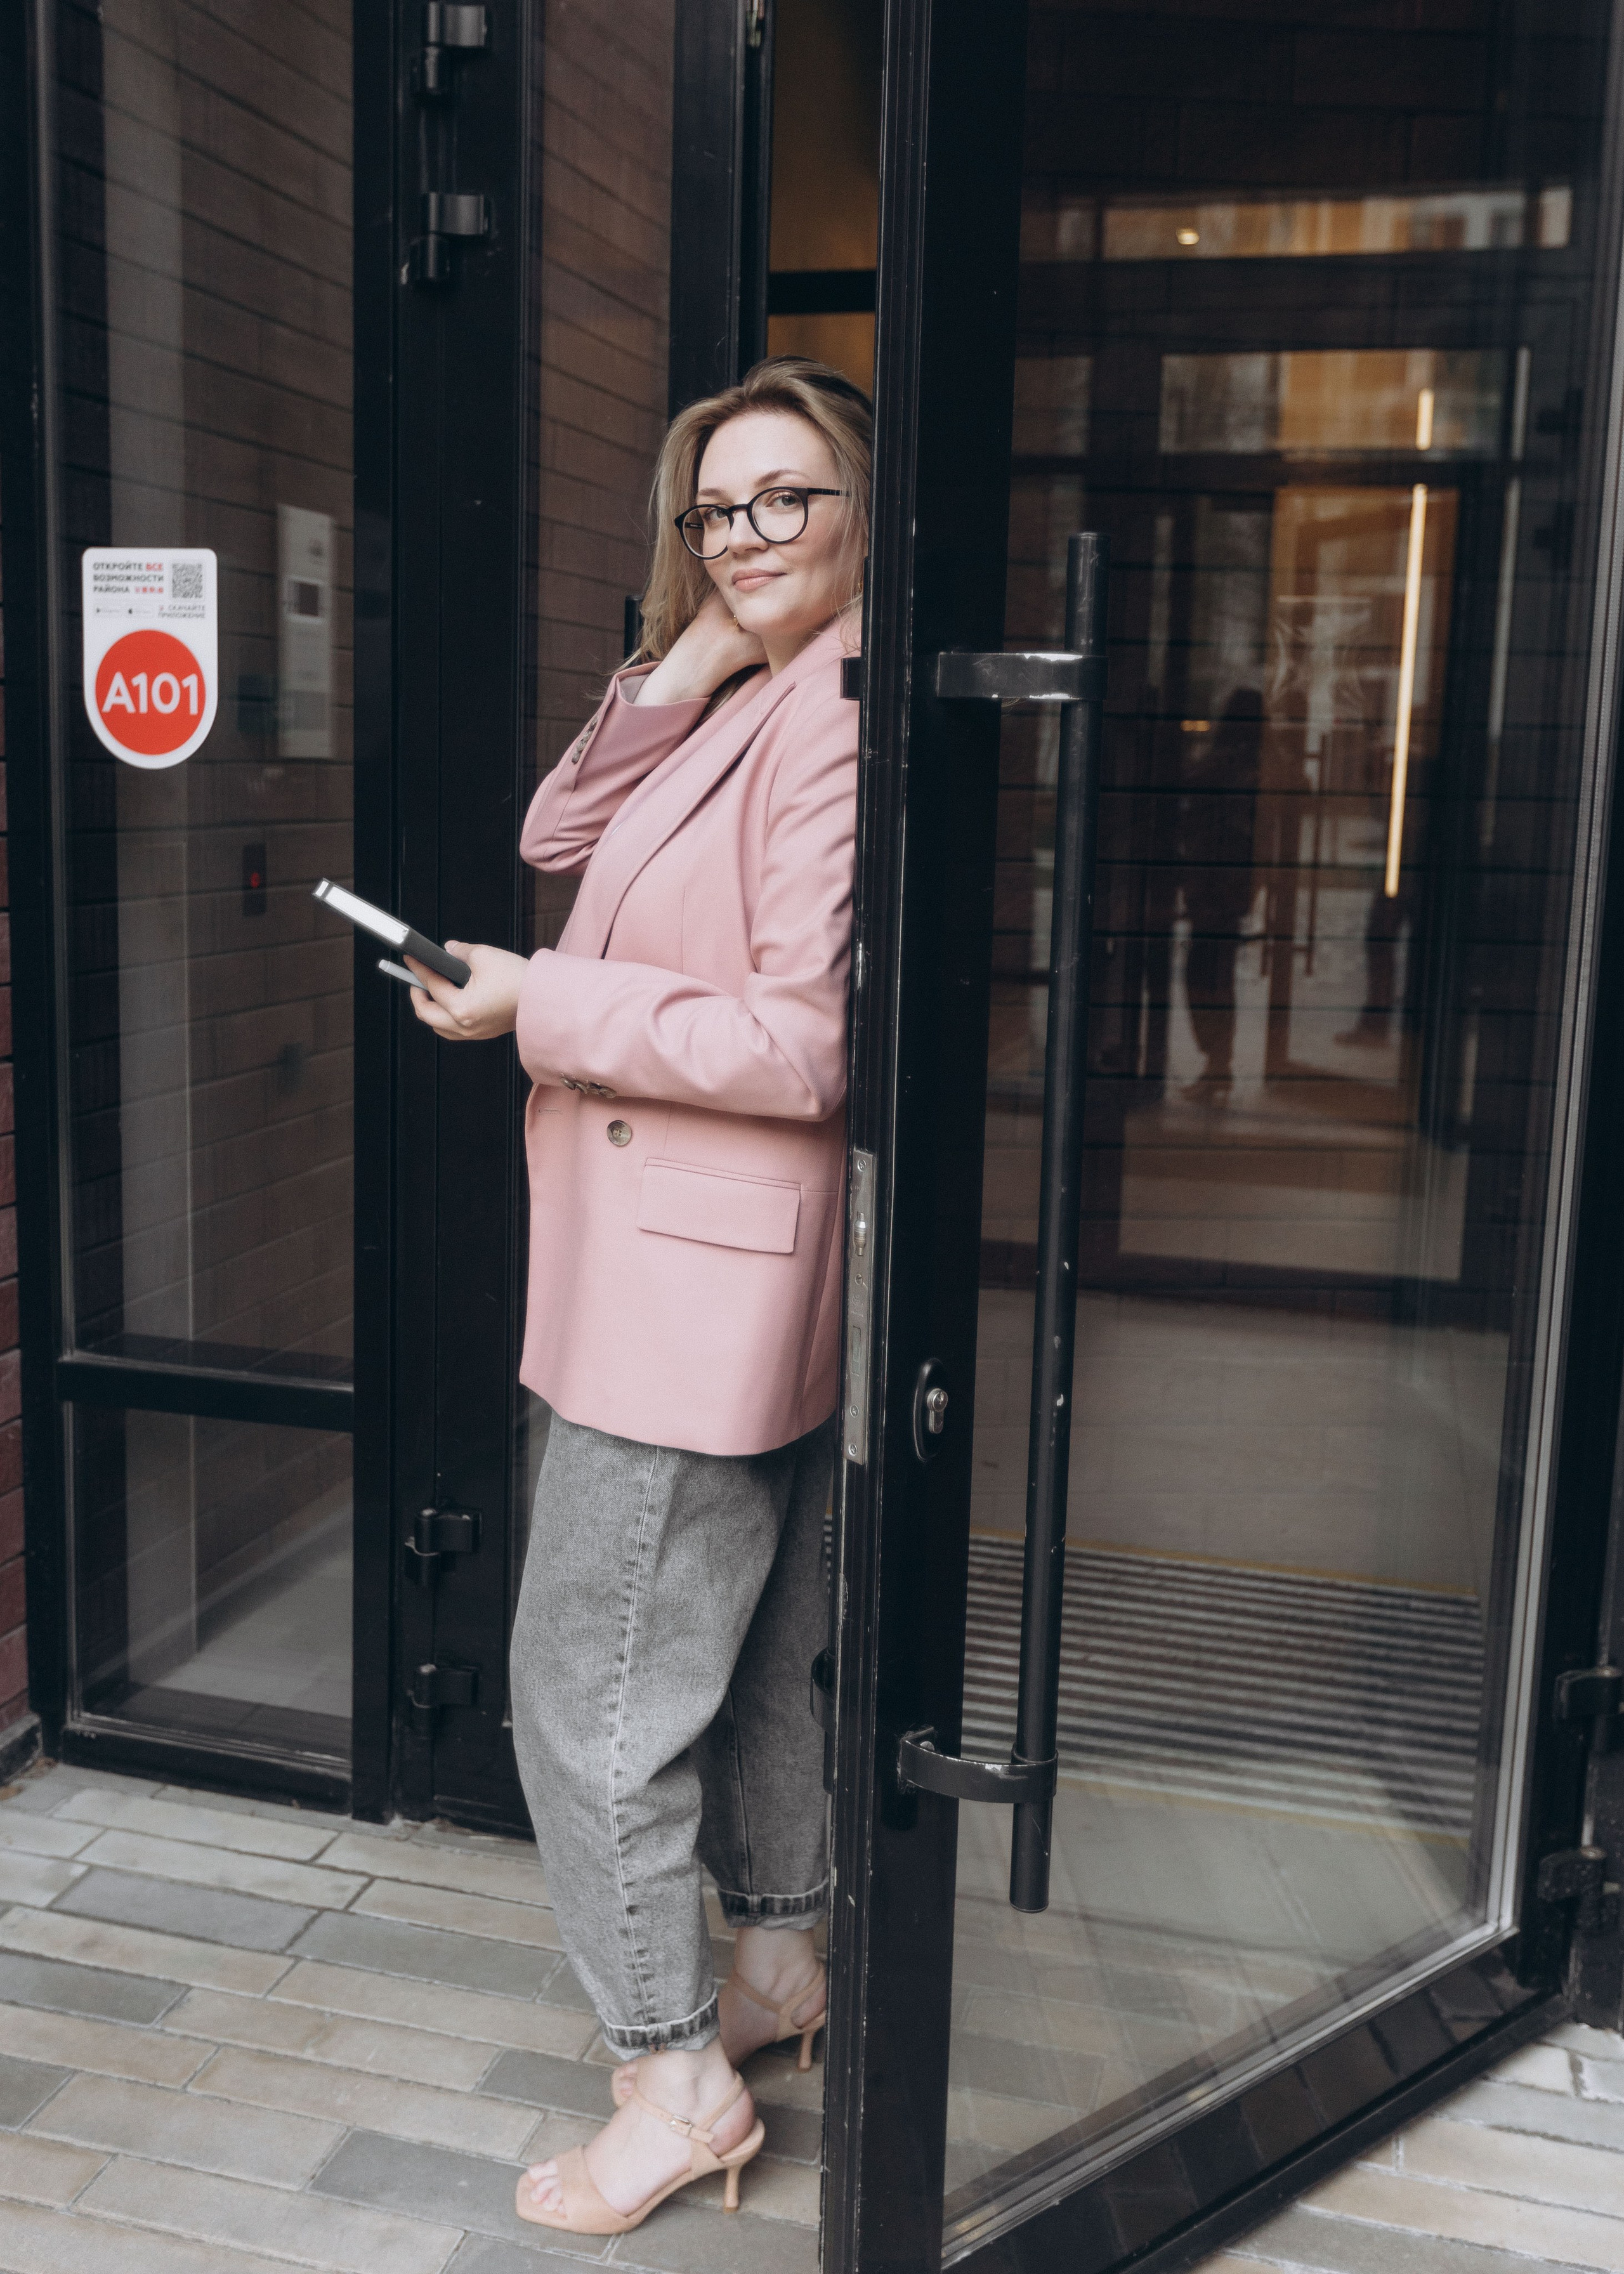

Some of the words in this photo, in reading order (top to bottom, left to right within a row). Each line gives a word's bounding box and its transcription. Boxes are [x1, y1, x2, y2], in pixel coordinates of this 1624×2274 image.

[93, 561, 143, 571] ОТКРОЙТЕ
[145, 562, 164, 572] ВСЕ
[93, 573, 164, 582] ВОЗМОЖНОСТИ
[93, 584, 130, 593] РАЙОНА
[102, 671, 199, 716] A101
